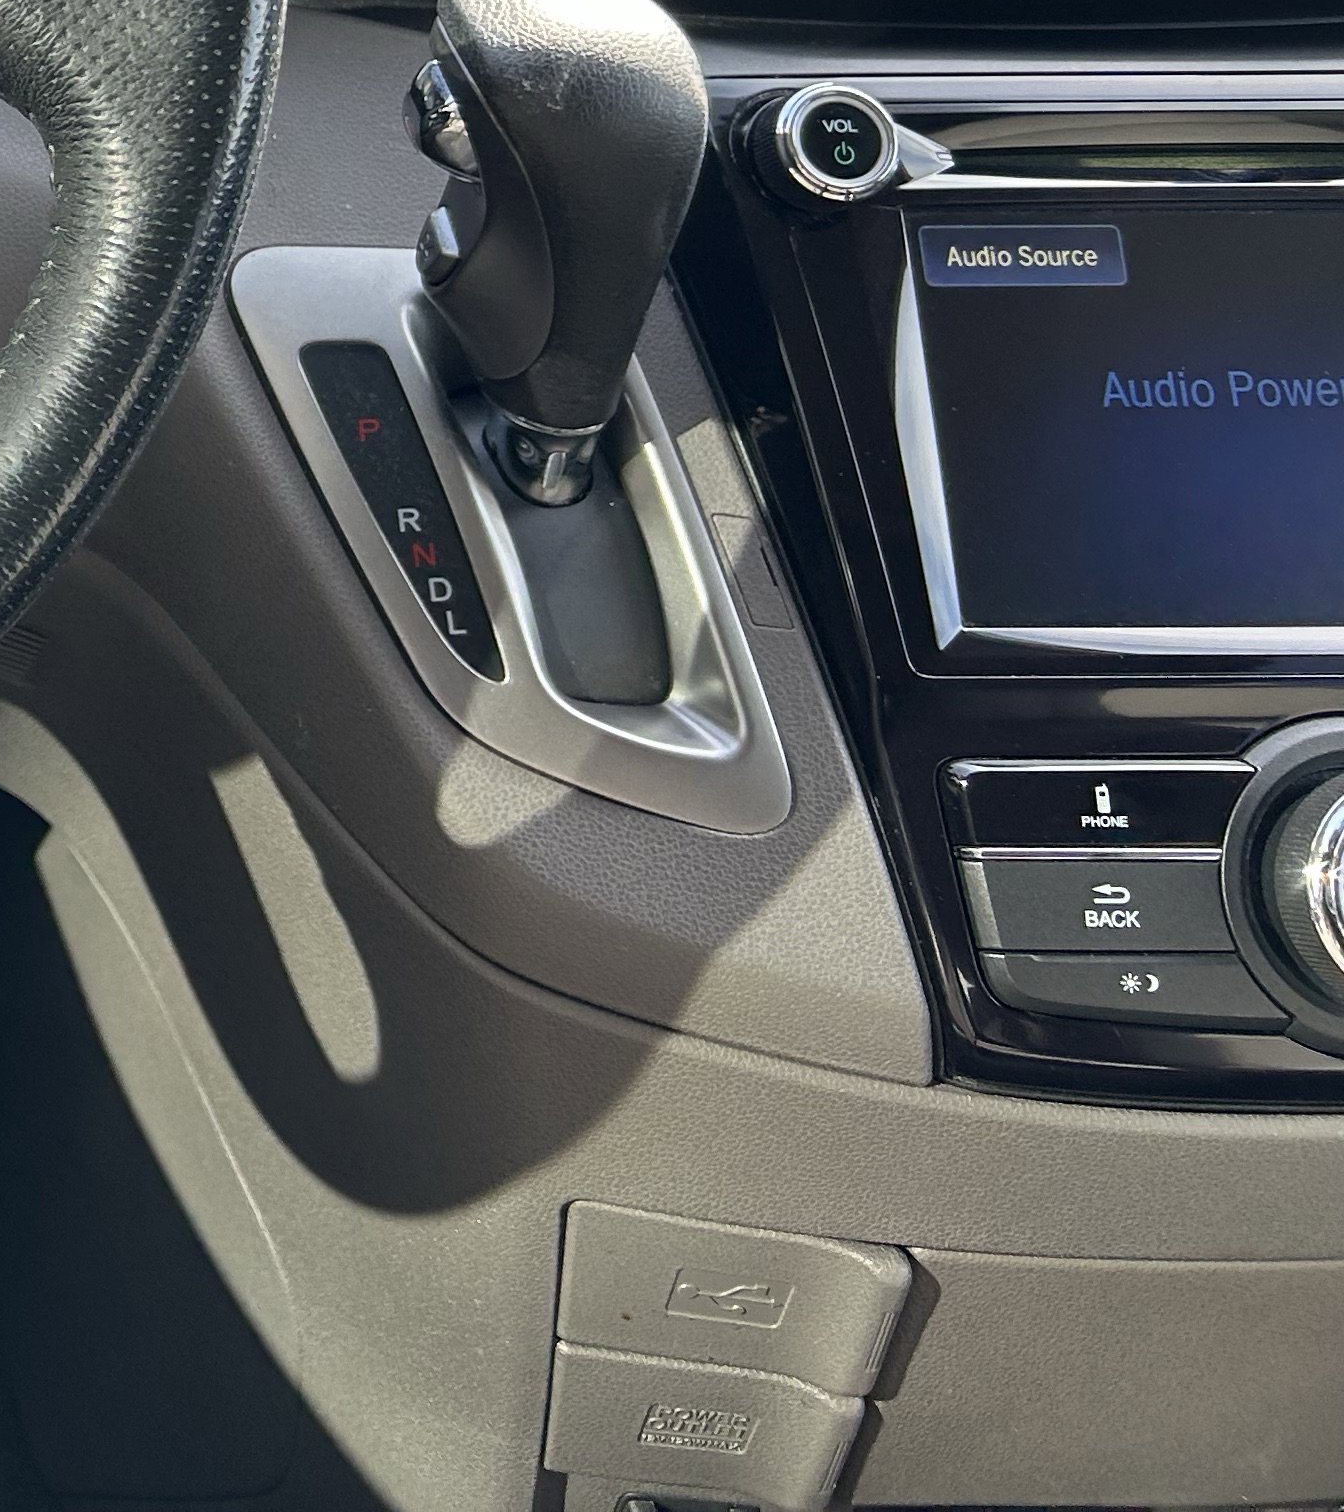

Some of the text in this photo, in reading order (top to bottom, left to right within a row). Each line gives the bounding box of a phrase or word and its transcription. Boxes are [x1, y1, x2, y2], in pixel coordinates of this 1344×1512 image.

[821, 119, 859, 134] VOL
[947, 245, 1099, 269] Audio Source
[1103, 369, 1216, 408] Audio
[358, 418, 380, 442] P
[398, 508, 420, 532] R
[412, 542, 436, 567] N
[429, 577, 453, 602] D
[447, 611, 467, 636] L
[1081, 815, 1129, 829] PHONE
[1084, 910, 1142, 929] BACK
